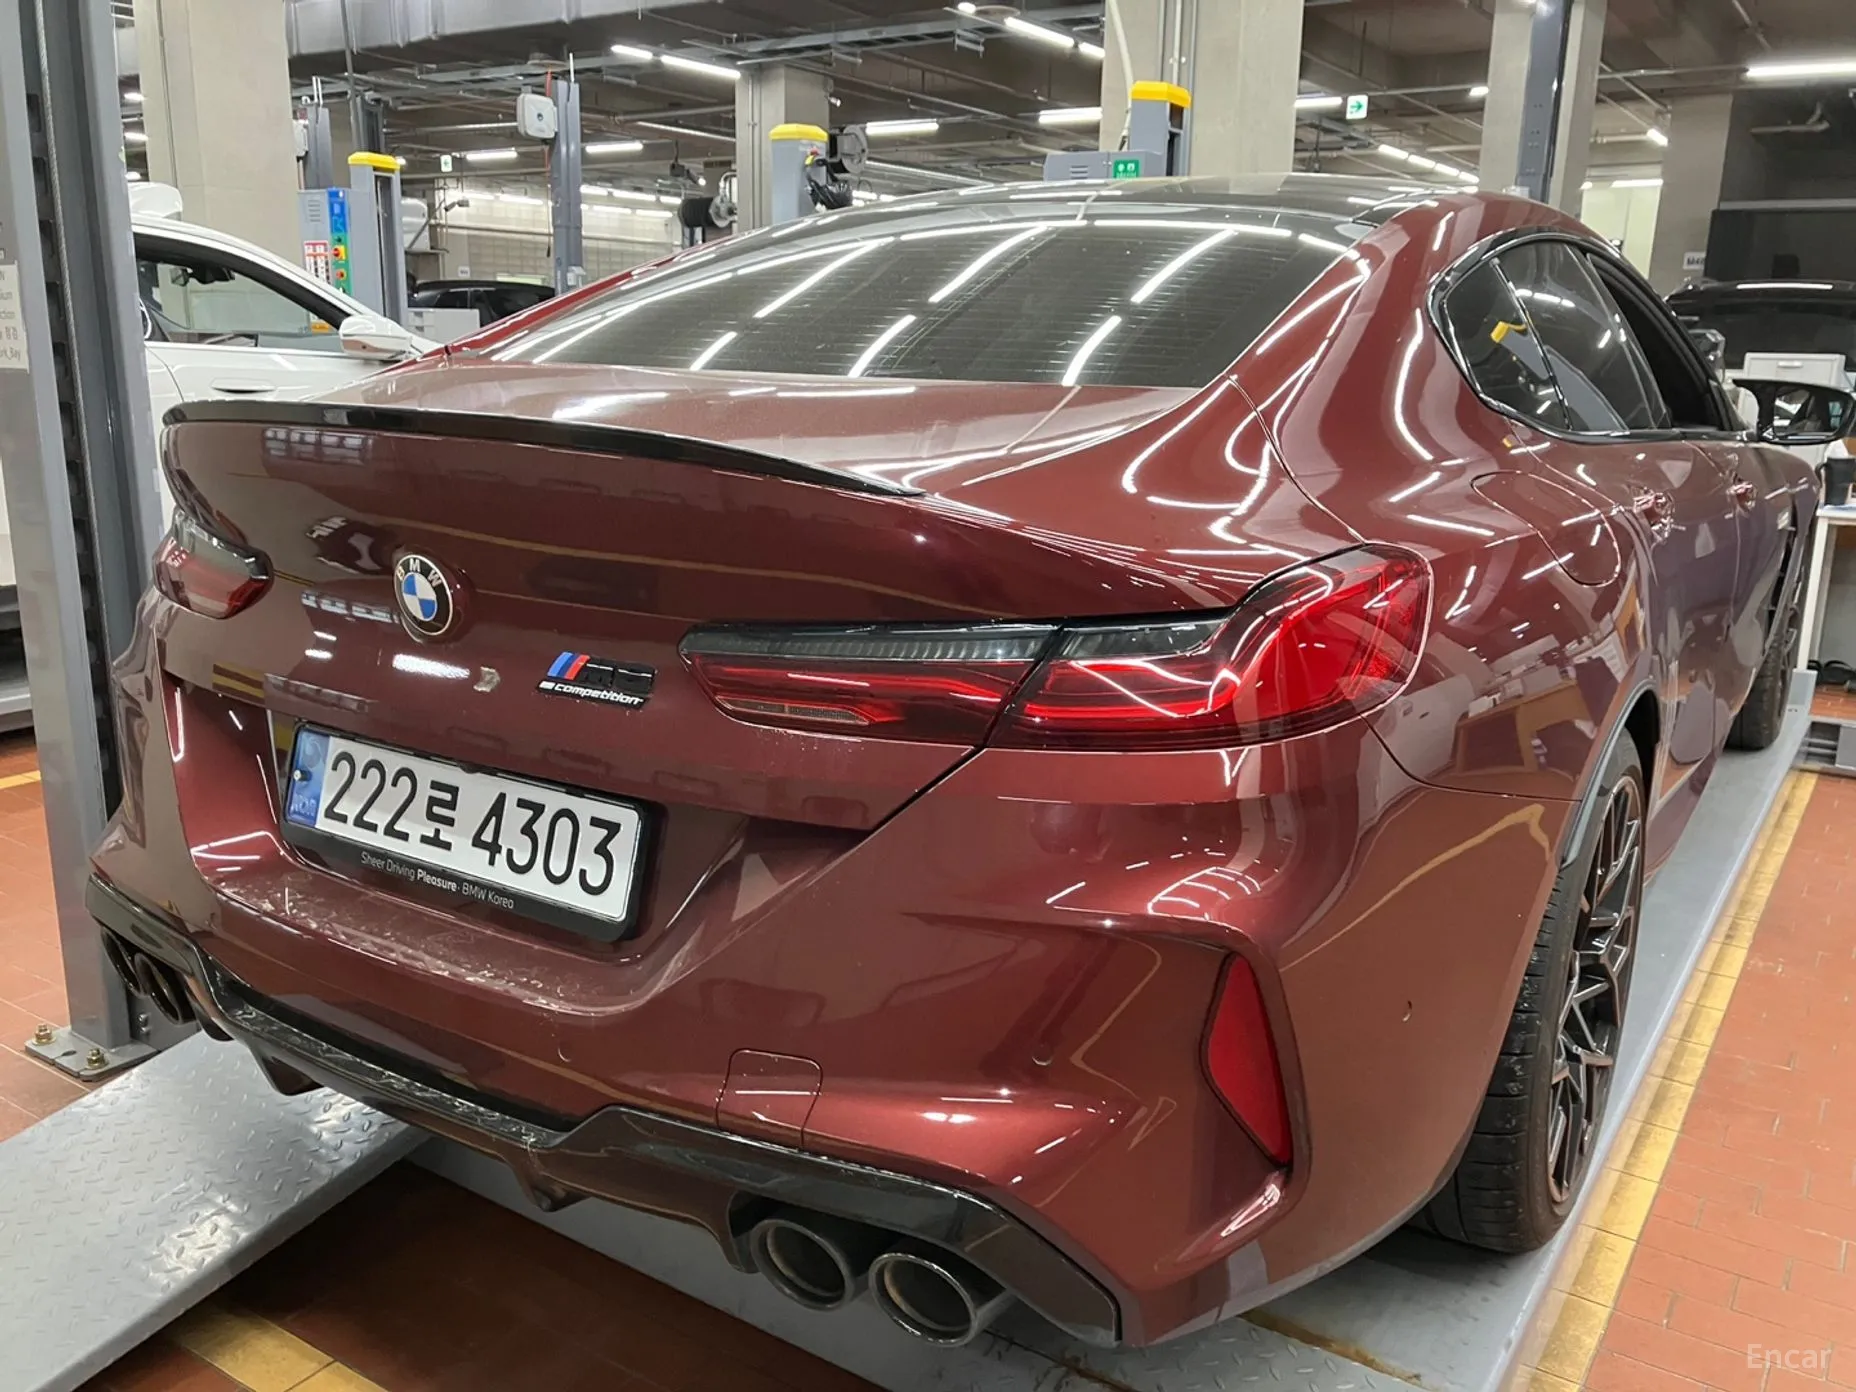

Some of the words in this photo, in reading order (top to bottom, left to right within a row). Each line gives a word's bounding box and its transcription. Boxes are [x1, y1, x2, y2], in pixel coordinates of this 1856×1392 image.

[396, 558, 443, 588] BMW
[554, 682, 644, 707] competition
[323, 751, 460, 852] 222로
[471, 791, 622, 897] 4303
[361, 851, 386, 871] Sheer
[386, 858, 416, 882] Driving
[416, 868, 457, 892] Pleasure
[462, 881, 486, 900] BMW
[488, 893, 515, 909] Korea
